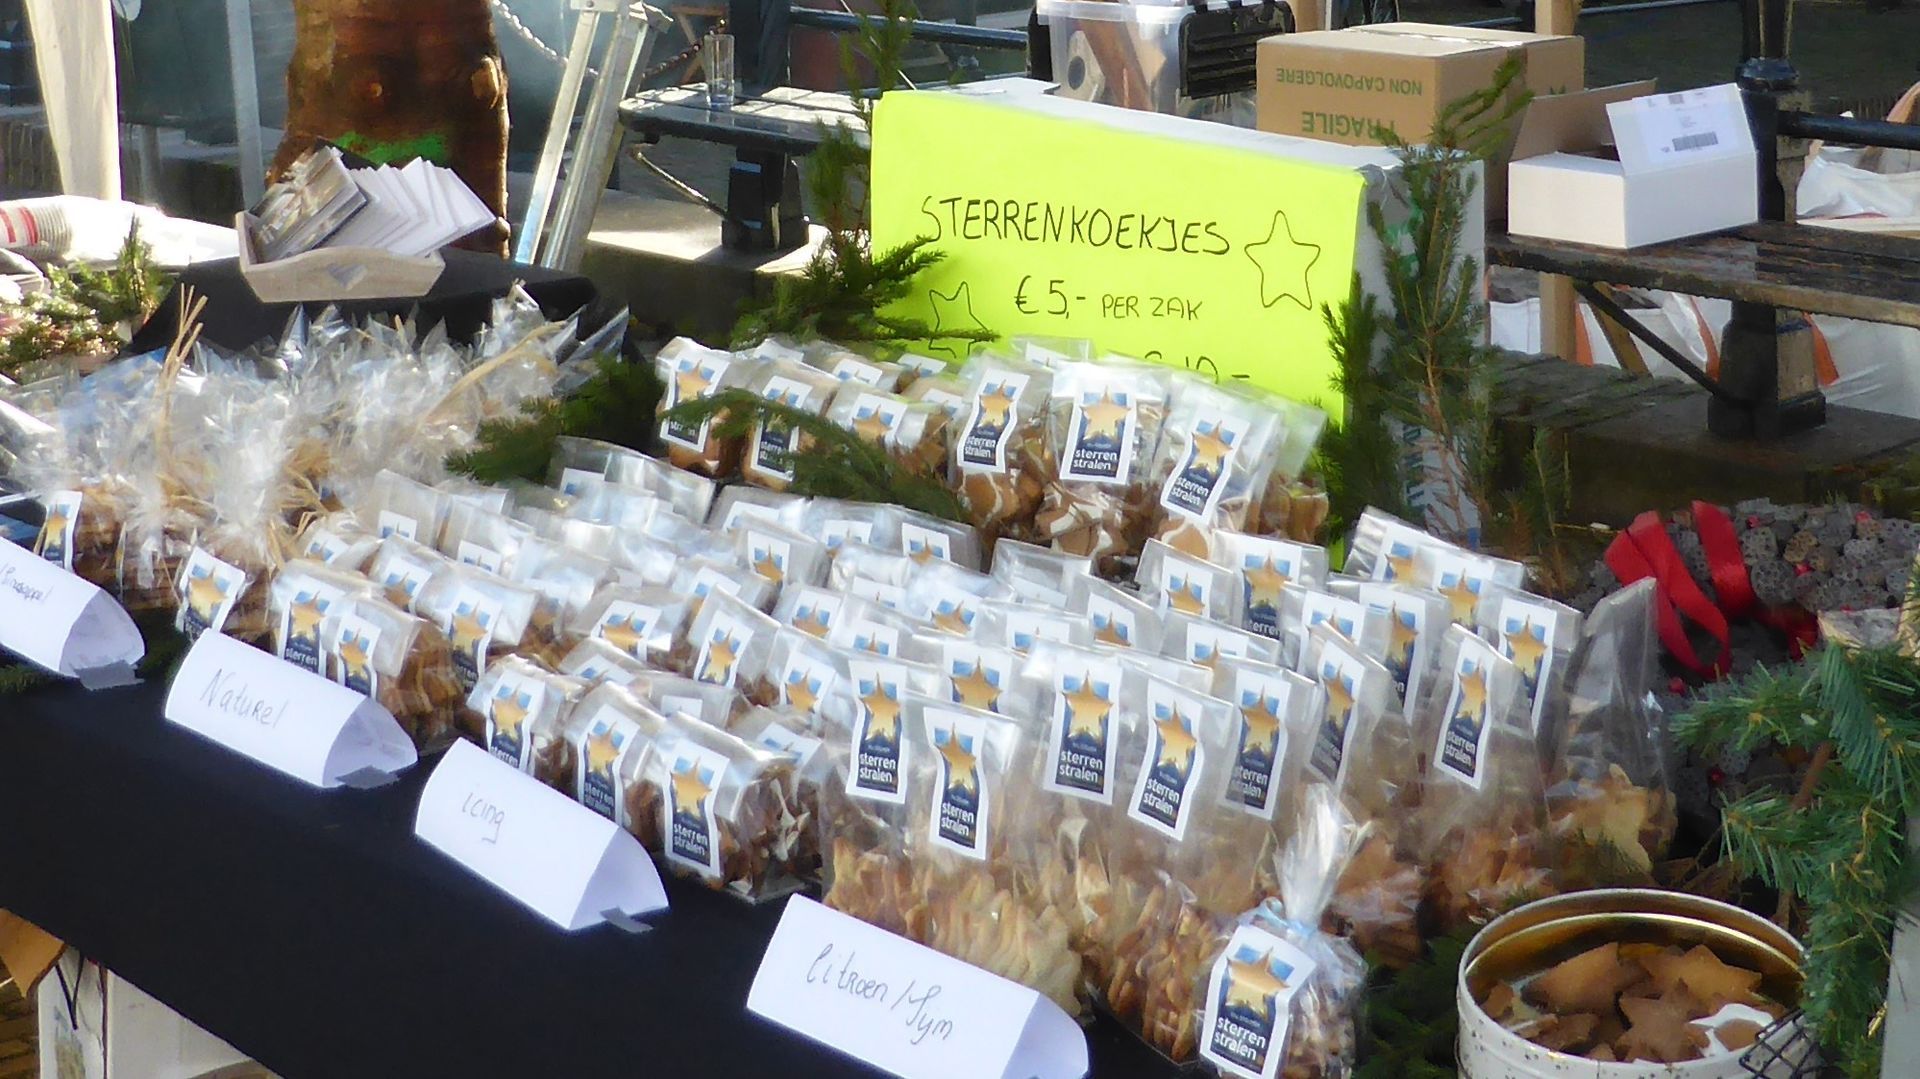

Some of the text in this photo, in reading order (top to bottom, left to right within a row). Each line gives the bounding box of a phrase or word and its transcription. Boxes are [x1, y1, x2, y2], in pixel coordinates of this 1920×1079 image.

[1276, 68, 1423, 96] NON CAPOVOLGERE
[921, 195, 1230, 255] STERRENKOEKJES
[1102, 293, 1139, 319] PER
[1149, 297, 1203, 320] ZAK
[1073, 458, 1112, 471] stralen
[1075, 448, 1118, 461] sterren
[1175, 476, 1209, 497] sterren
[859, 752, 897, 770] sterren
[1060, 750, 1104, 771] sterren
[859, 767, 893, 783] stralen
[1059, 764, 1099, 783] stralen
[1146, 777, 1181, 804] sterren
[941, 801, 975, 824] sterren
[1142, 791, 1174, 815] stralen
[673, 823, 708, 846] sterren
[940, 816, 970, 837] stralen
[673, 836, 705, 856] stralen
[1216, 1016, 1267, 1049] sterren
[1213, 1031, 1258, 1061] stralen
